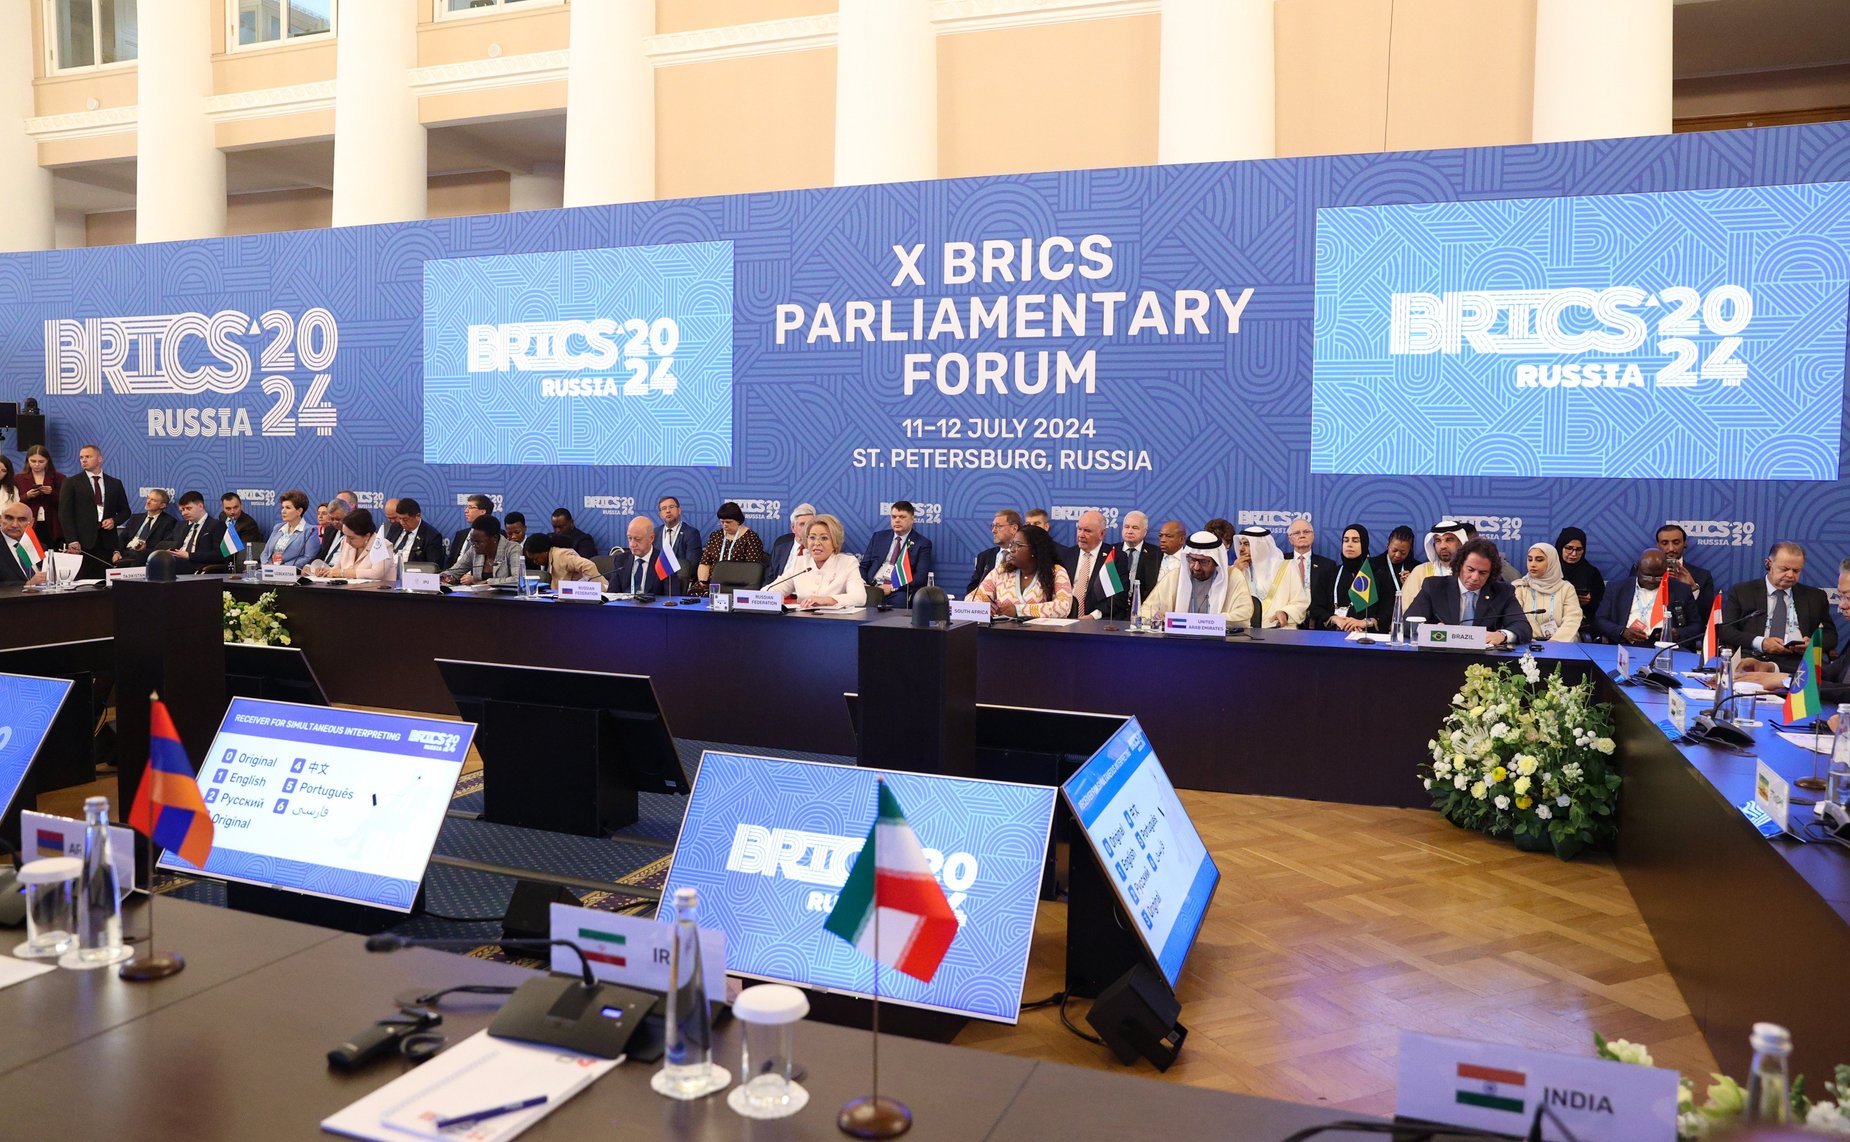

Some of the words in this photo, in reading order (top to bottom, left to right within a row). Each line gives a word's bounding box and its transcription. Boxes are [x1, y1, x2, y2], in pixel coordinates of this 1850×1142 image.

[890, 243, 926, 286] X
[943, 234, 1114, 284] BRICS
[775, 288, 1255, 345] PARLIAMENTARY
[1390, 284, 1647, 354] BRICS
[44, 310, 252, 395] BRICS
[468, 318, 619, 372] BRICS
[903, 350, 1097, 396] FORUM
[1516, 363, 1644, 388] RUSSIA
[542, 378, 618, 397] RUSSIA
[148, 407, 252, 436] RUSSIA
[967, 418, 1028, 438] JULY
[1033, 418, 1096, 438] 2024
[852, 448, 884, 468] ST.
[891, 448, 1052, 472] PETERSBURG,
[1060, 450, 1153, 471] RUSSIA
[1238, 510, 1292, 526] BRICS
[235, 714, 270, 726] RECEIVER
[270, 720, 286, 728] FOR
[286, 720, 344, 735] SIMULTANEOUS
[344, 727, 401, 742] INTERPRETING
[238, 753, 278, 768] Original
[308, 761, 330, 776] 中文
[230, 772, 266, 787] English
[300, 782, 354, 800] Português
[220, 792, 264, 808] Русский
[212, 814, 252, 829] Original
[1544, 1086, 1614, 1114] INDIA
